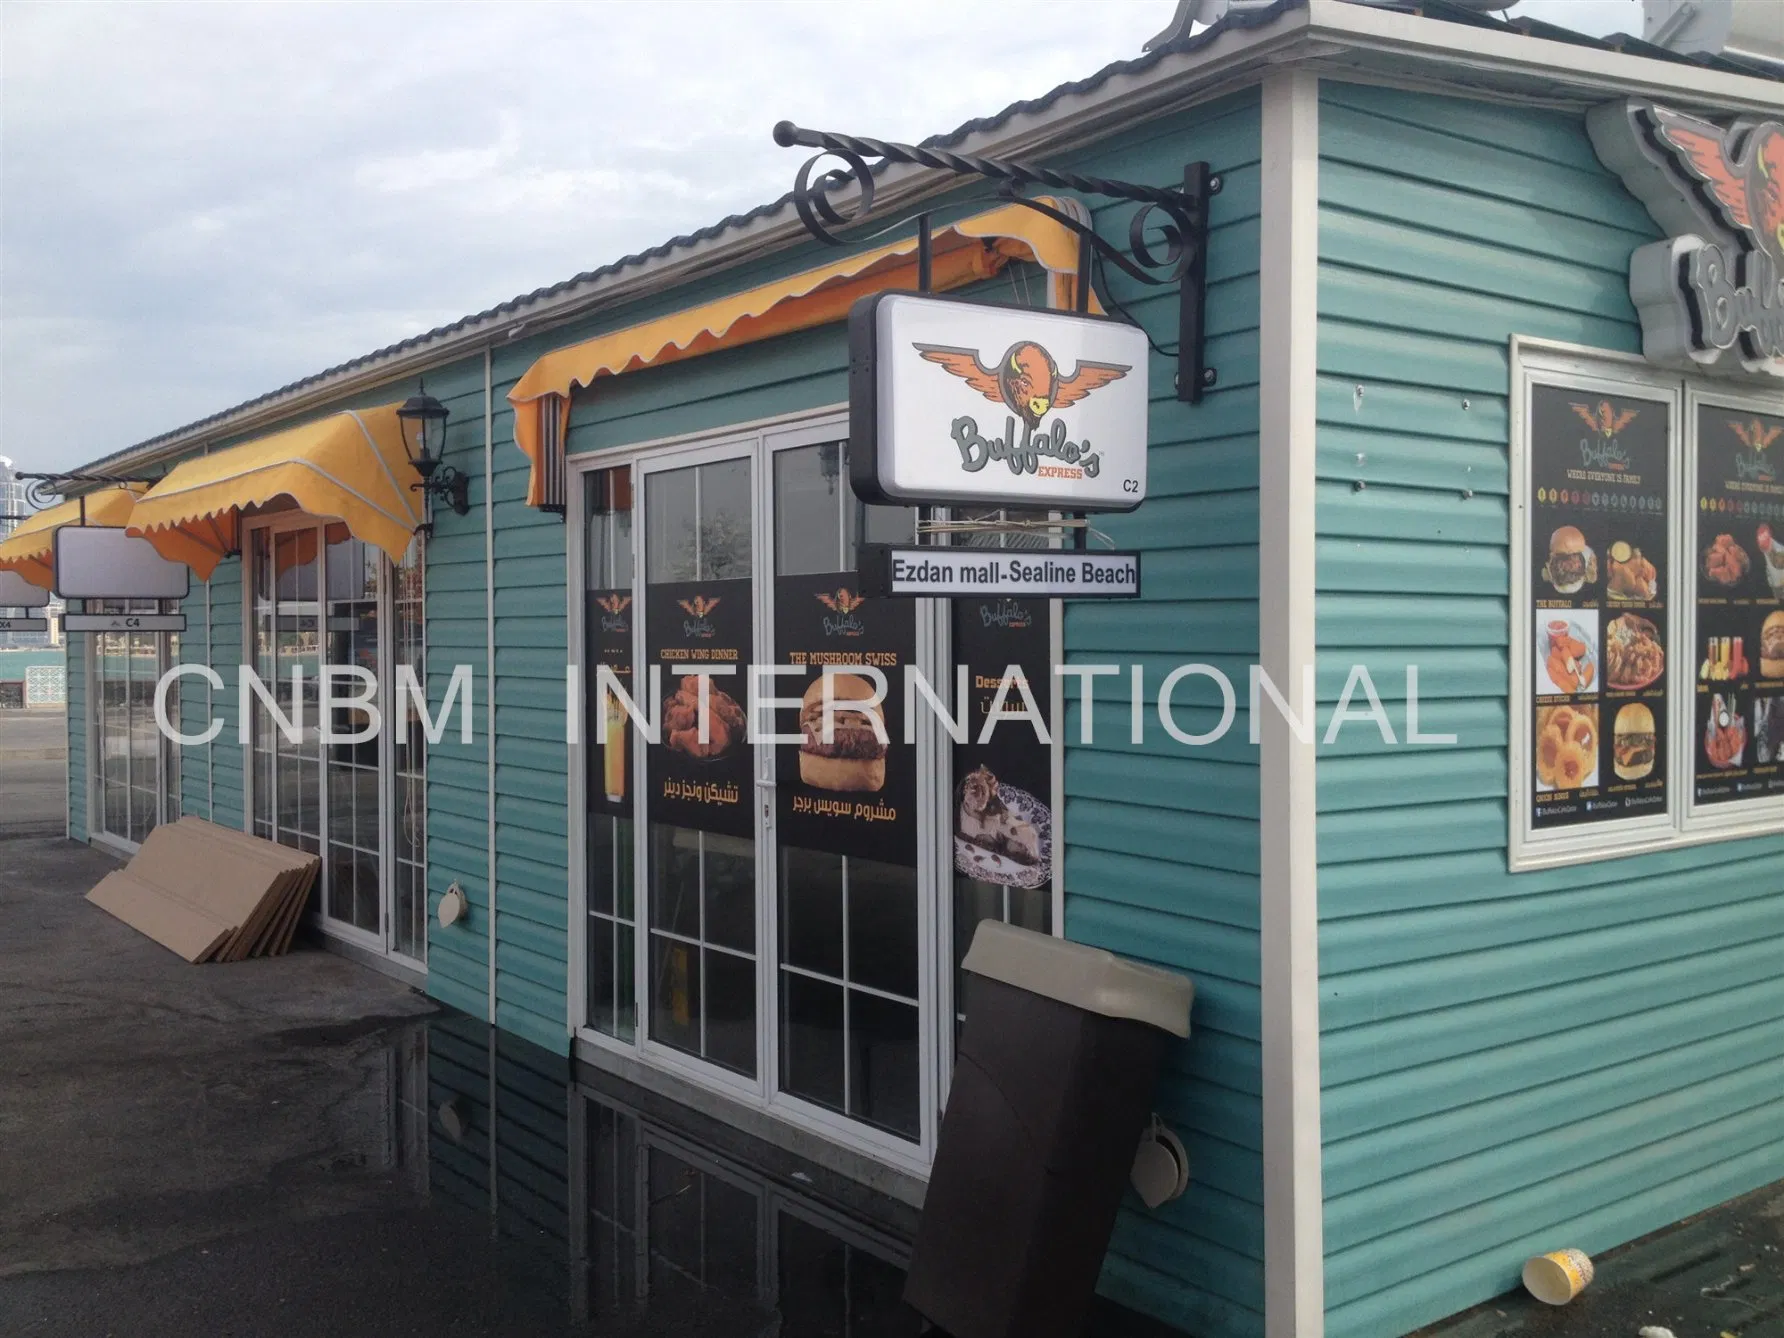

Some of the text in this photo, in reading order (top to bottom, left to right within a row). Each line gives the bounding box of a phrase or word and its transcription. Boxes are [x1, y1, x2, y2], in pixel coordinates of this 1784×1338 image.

[951, 415, 1100, 478] Buffalo's
[1038, 466, 1083, 480] EXPRESS
[1123, 479, 1139, 493] C2
[892, 559, 953, 583] Ezdan
[1082, 562, 1137, 585] Beach
[125, 617, 140, 628] C4
[980, 602, 1032, 627] Buffalo's
[660, 648, 738, 660] CHICKEN WING DINNER
[789, 652, 897, 666] THE MUSHROOM SWISS
[663, 777, 681, 798] دينر
[704, 781, 738, 806] تشيكن
[792, 795, 897, 822] مشروم سويس برجر
